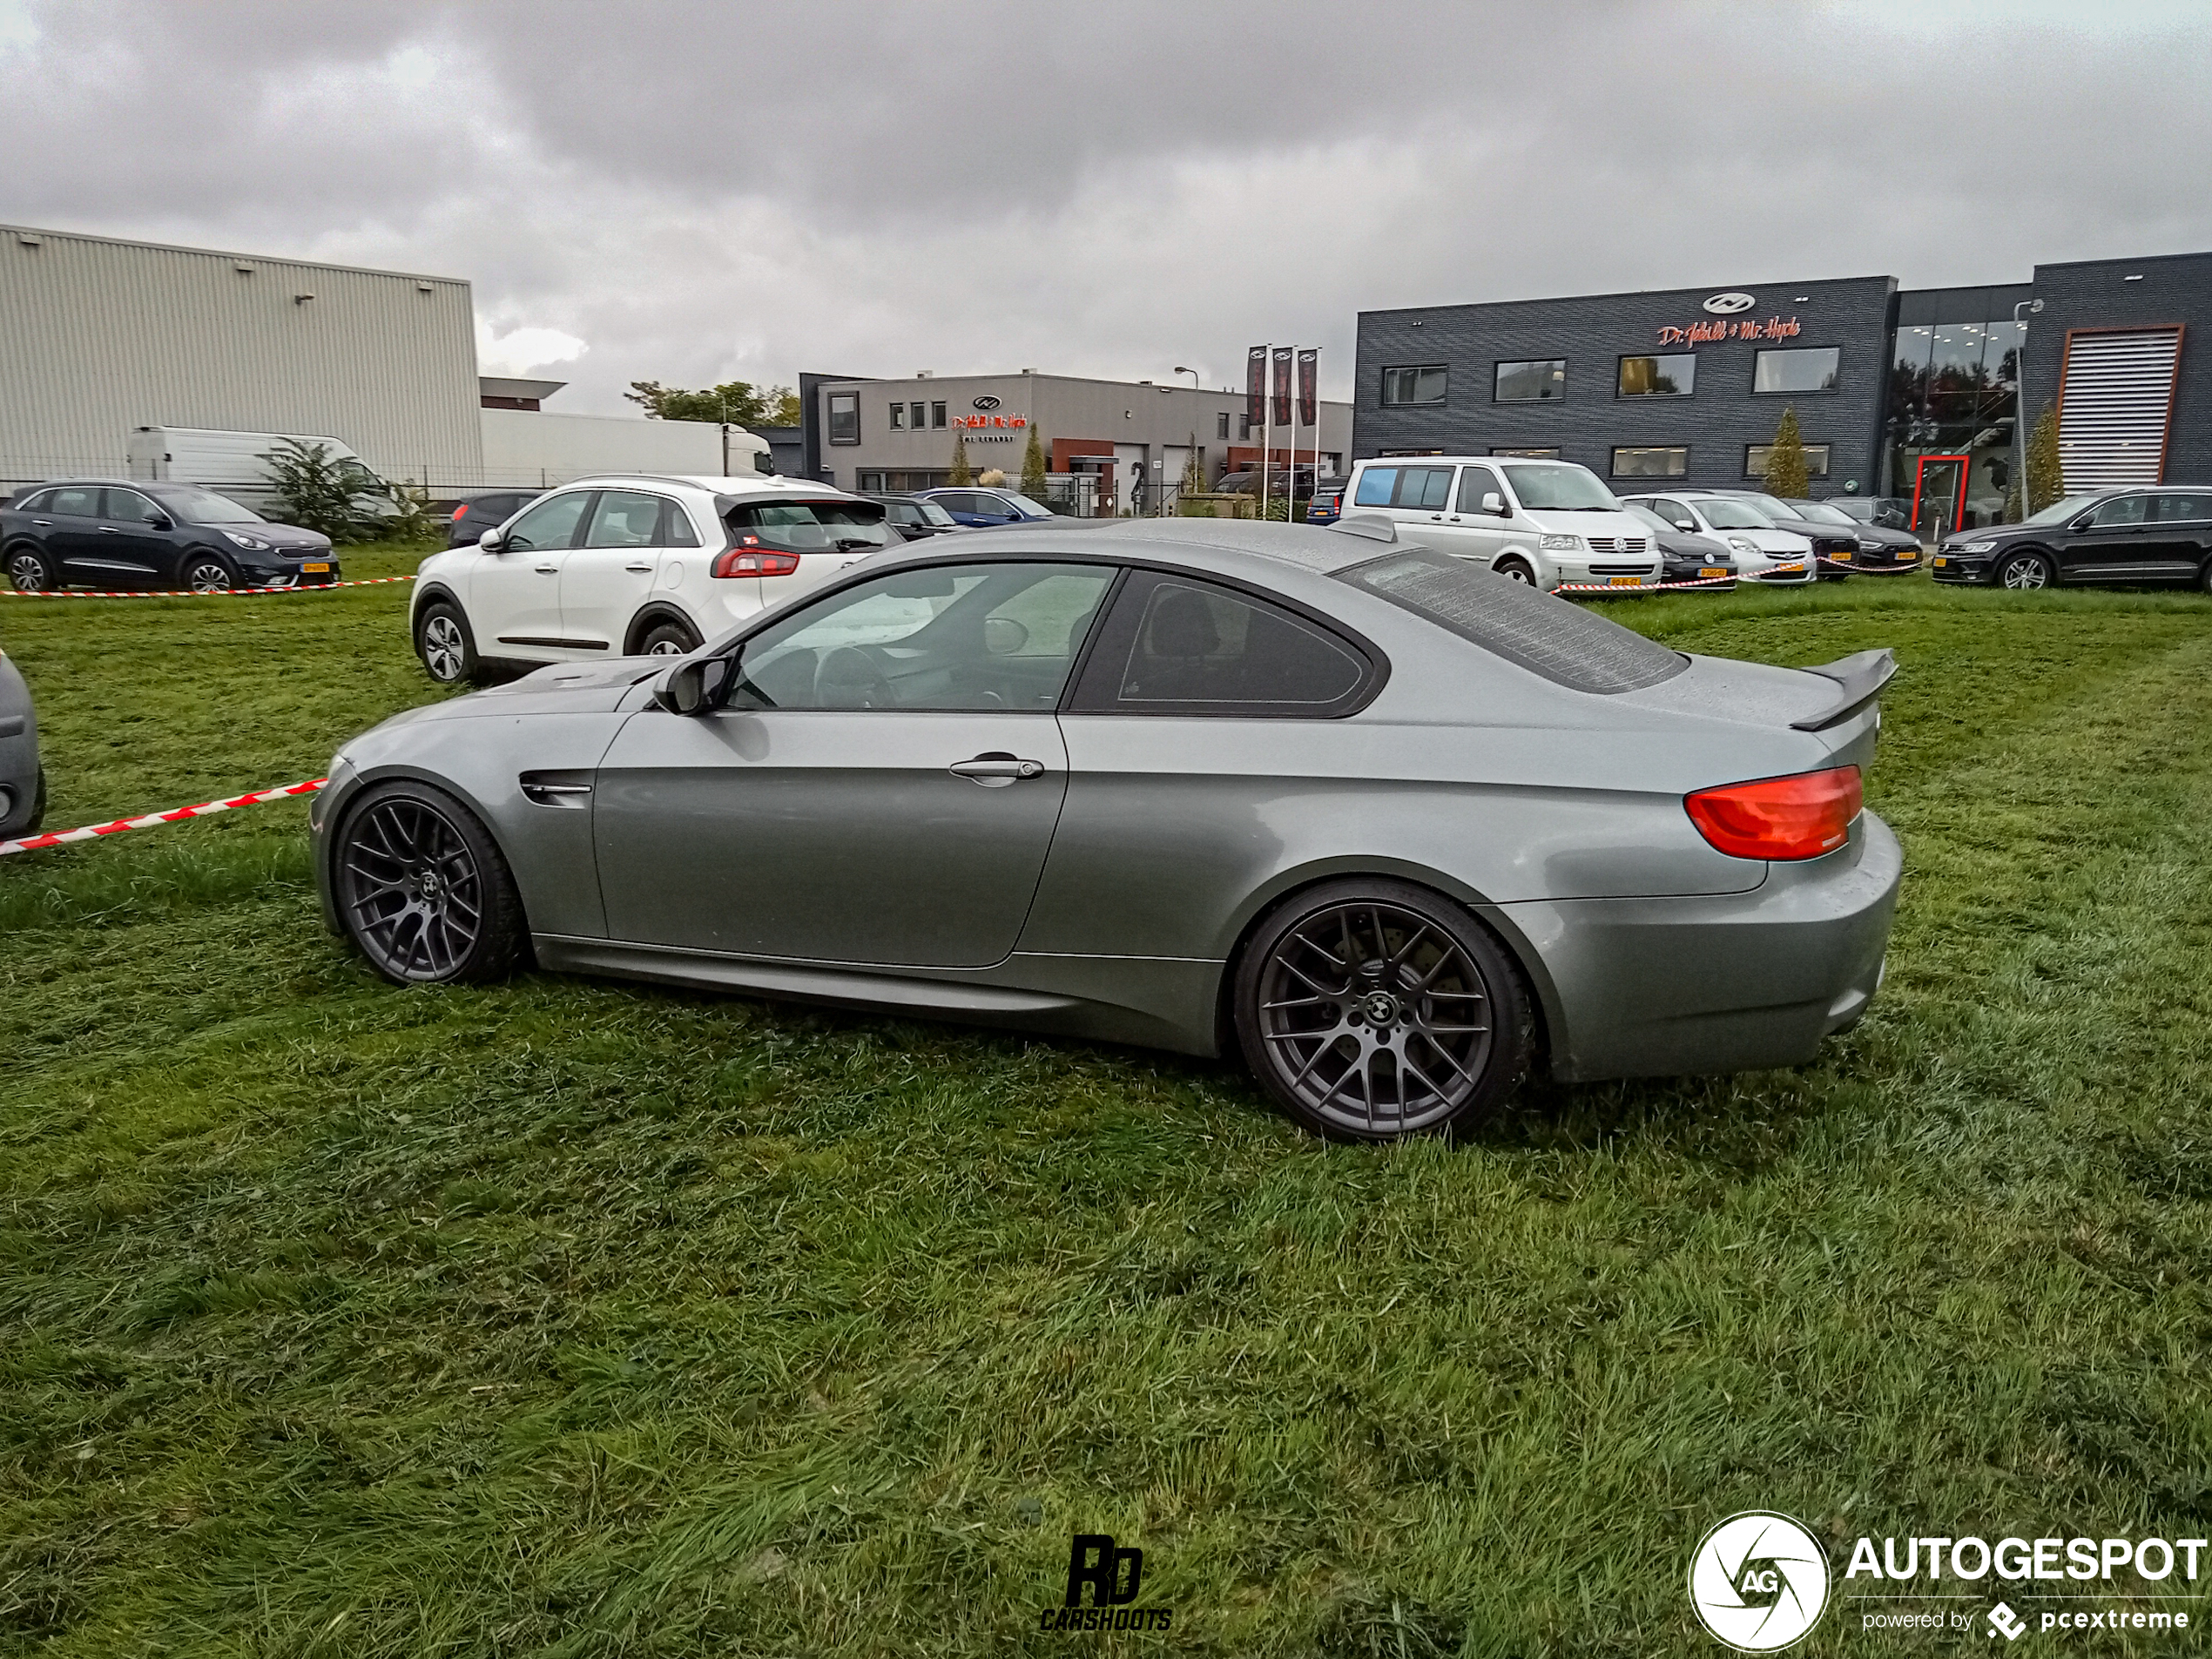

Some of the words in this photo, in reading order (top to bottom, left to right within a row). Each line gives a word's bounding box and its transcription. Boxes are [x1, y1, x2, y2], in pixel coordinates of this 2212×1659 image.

[1657, 326, 1684, 346] Dr.
[1740, 320, 1763, 341] Mr.
[1763, 315, 1802, 344] Hyde
